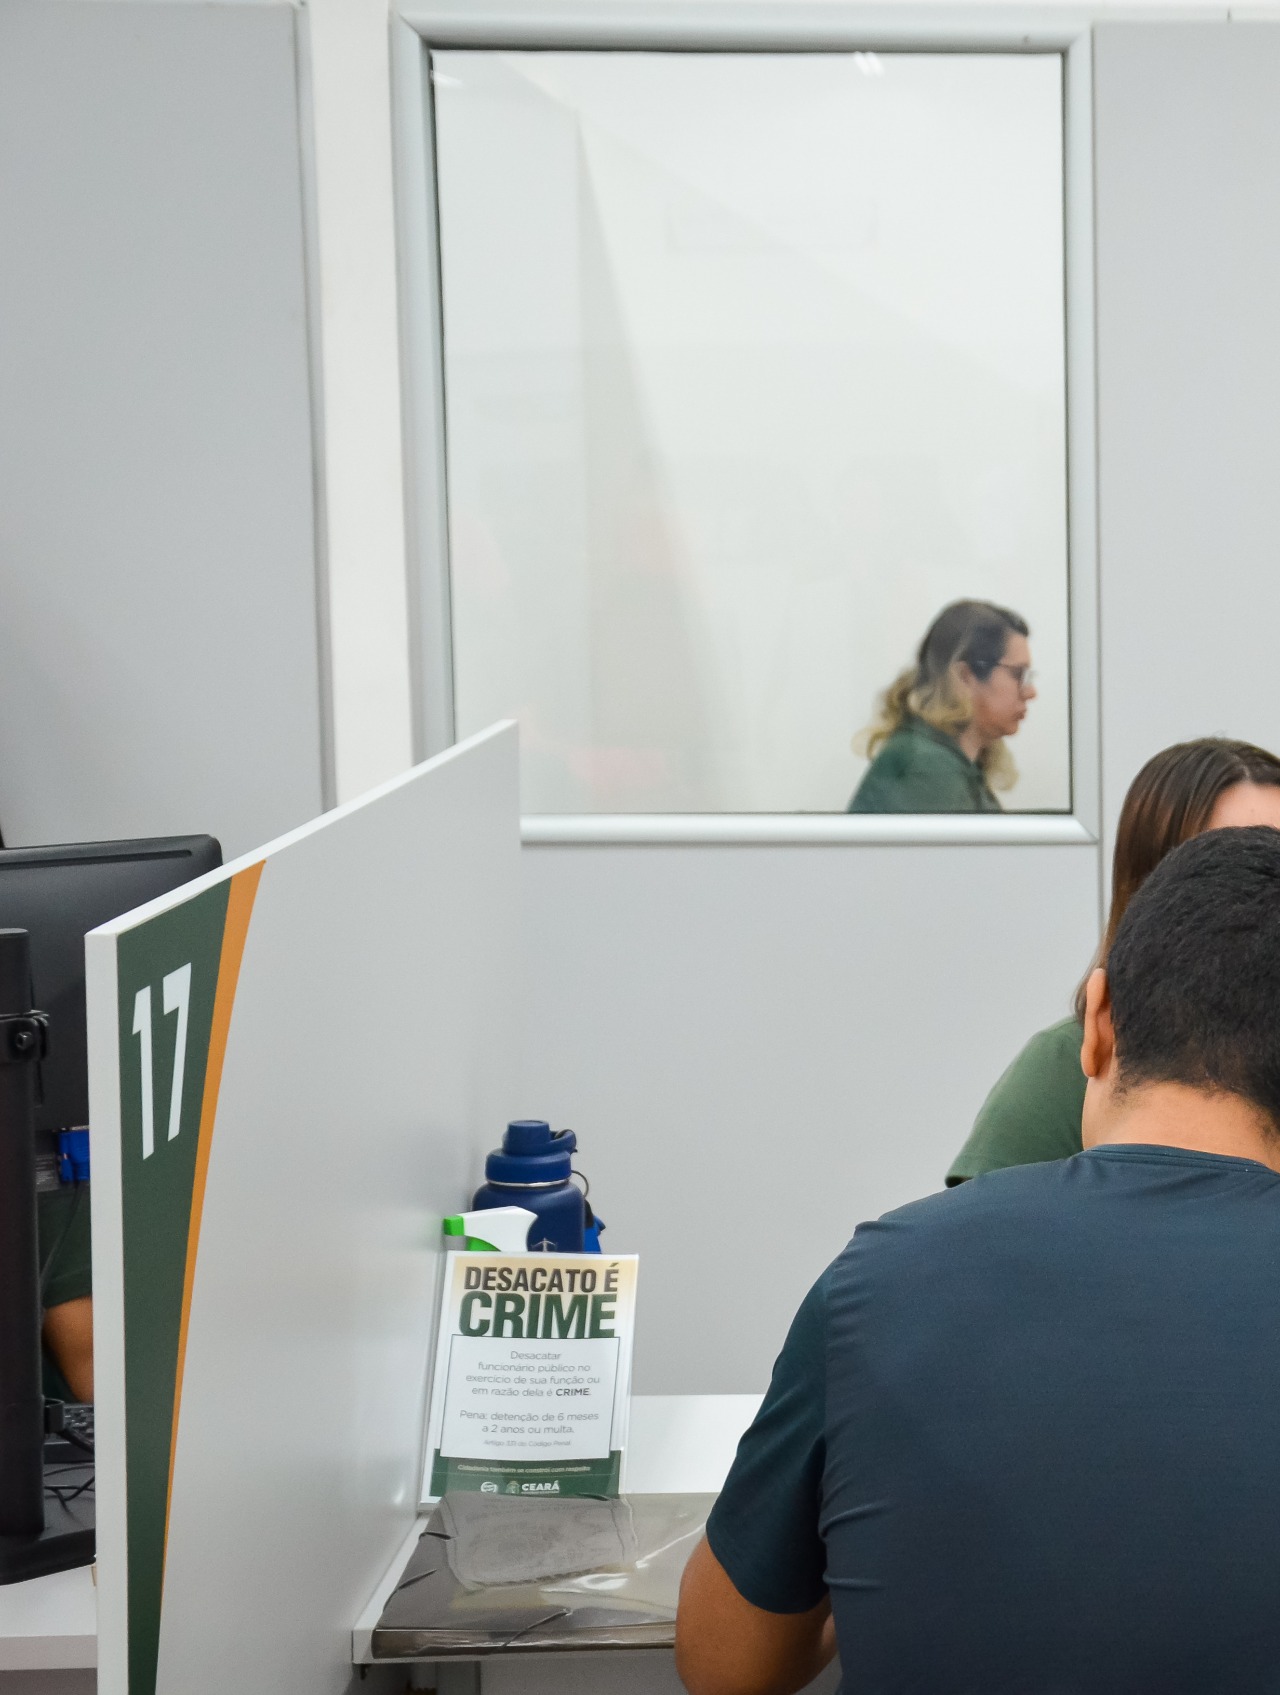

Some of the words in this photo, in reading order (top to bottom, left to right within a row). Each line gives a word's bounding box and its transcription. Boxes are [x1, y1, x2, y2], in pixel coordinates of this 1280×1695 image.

[131, 962, 192, 1161] 17
[464, 1266, 597, 1293] DESACATO
[604, 1262, 619, 1292] É
[458, 1291, 618, 1338] CRIME
[510, 1350, 561, 1360] Desacatar
[478, 1361, 535, 1372] funcionário
[537, 1363, 575, 1373] público
[577, 1364, 591, 1372] no
[466, 1374, 511, 1384] exercício
[513, 1375, 527, 1385] de
[529, 1377, 547, 1385] sua
[550, 1374, 585, 1386] função
[587, 1376, 600, 1384] ou
[472, 1387, 488, 1395] em
[491, 1387, 519, 1397] razão
[522, 1387, 544, 1397] dela
[546, 1387, 553, 1397] é
[459, 1409, 488, 1420] Pena:
[490, 1411, 539, 1422] detenção
[541, 1411, 555, 1422] de
[557, 1412, 565, 1421] 6
[567, 1413, 600, 1421] meses
[482, 1425, 489, 1433] a
[491, 1424, 498, 1433] 2
[500, 1425, 525, 1434] anos
[527, 1426, 541, 1434] ou
[543, 1424, 575, 1434] multa.
[521, 1480, 560, 1491] CEARÁ
